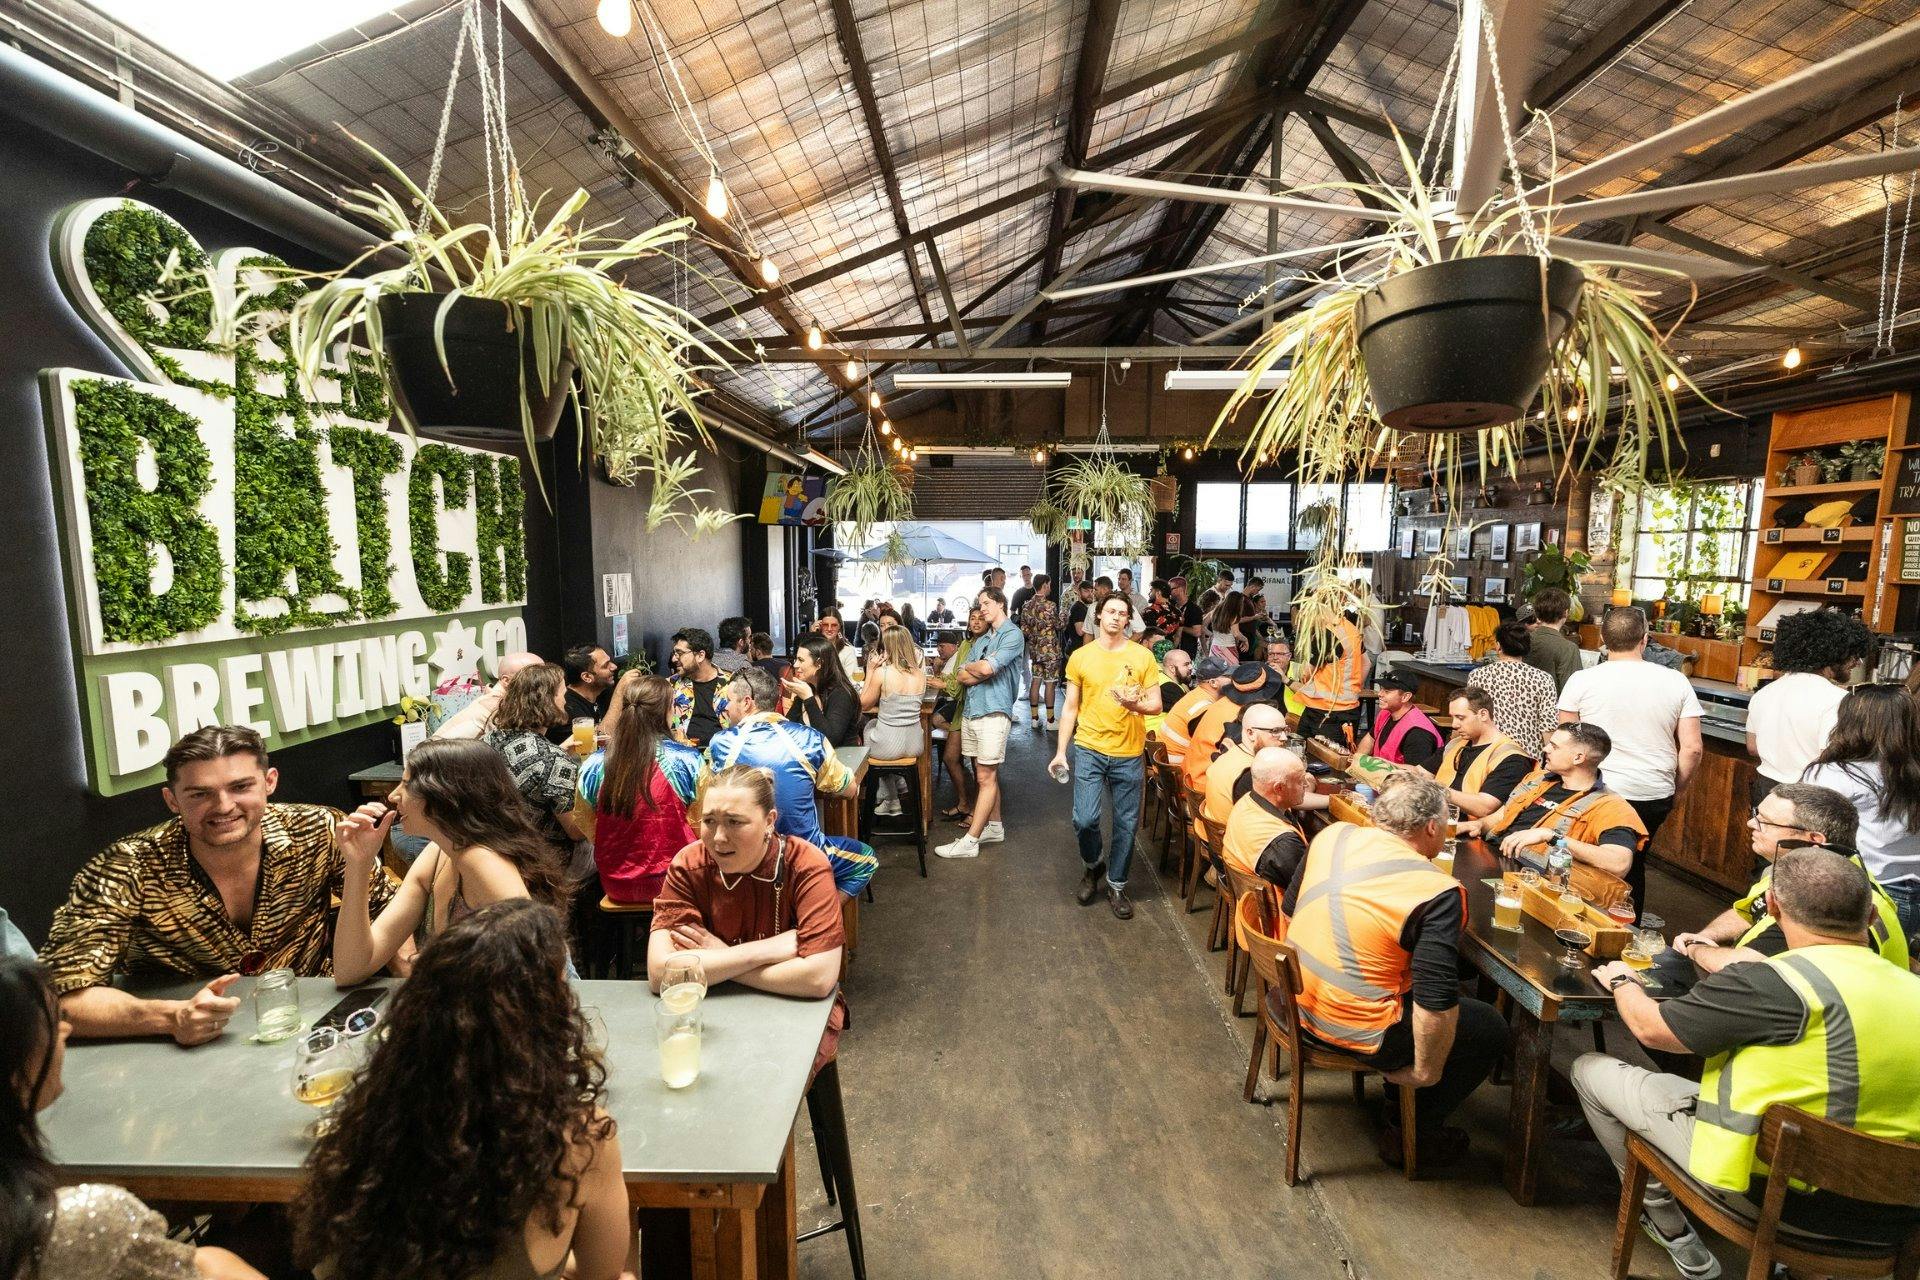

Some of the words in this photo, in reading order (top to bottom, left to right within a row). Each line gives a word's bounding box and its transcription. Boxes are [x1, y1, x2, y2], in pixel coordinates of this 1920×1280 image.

[1900, 485, 1916, 498] TRY
[101, 628, 431, 776] BREWING
[482, 616, 528, 680] CO
